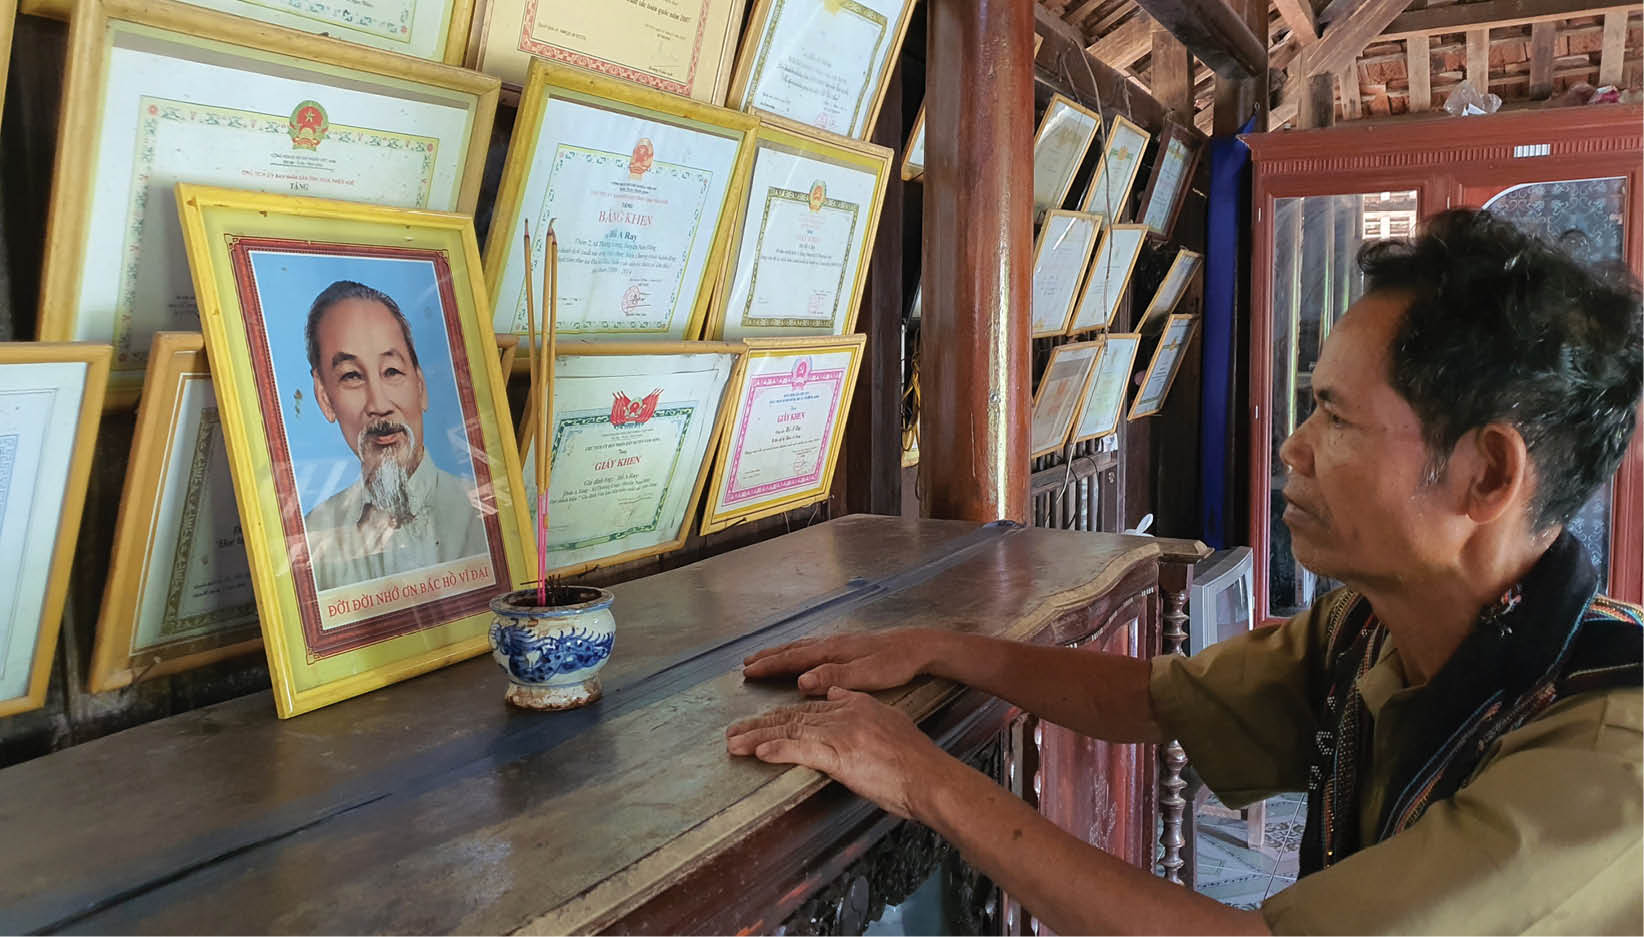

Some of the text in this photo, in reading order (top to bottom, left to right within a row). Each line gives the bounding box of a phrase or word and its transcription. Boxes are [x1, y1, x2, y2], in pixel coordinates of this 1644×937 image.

[616, 456, 642, 468] KHEN
[328, 599, 351, 617] ĐỜI
[352, 593, 375, 611] ĐỜI
[375, 584, 400, 605] NHỚ
[402, 583, 418, 598] ƠN
[419, 576, 441, 594] BÁC
[442, 570, 458, 588] HỒ
